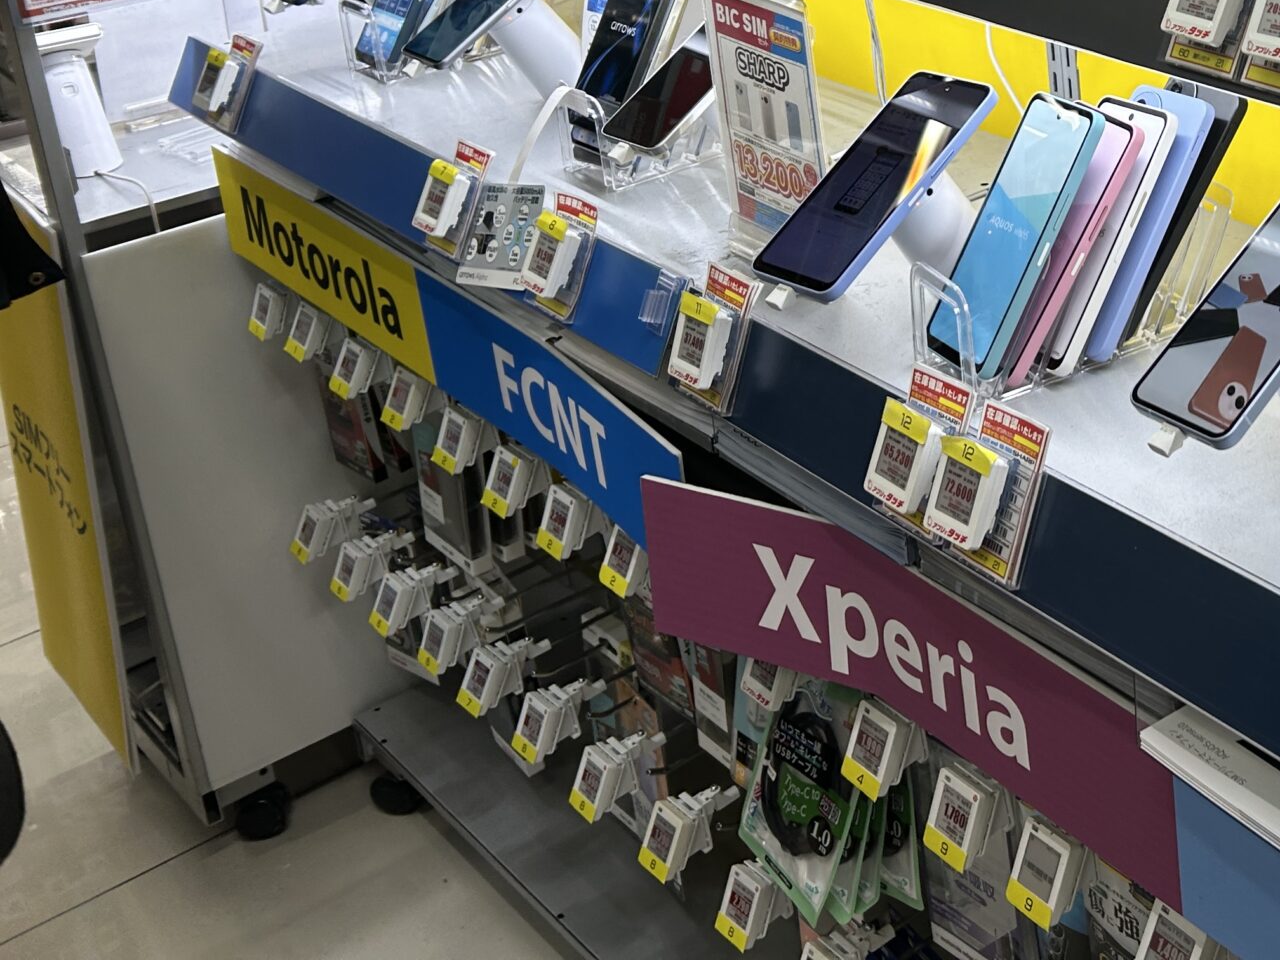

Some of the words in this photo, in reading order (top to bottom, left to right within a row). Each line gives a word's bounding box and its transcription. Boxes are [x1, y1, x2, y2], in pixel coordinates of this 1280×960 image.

[610, 20, 637, 37] arrows
[715, 2, 740, 28] BIC
[742, 13, 768, 39] SIM
[737, 48, 788, 88] SHARP
[989, 215, 1015, 233] AQUOS
[240, 186, 404, 341] Motorola
[492, 342, 607, 490] FCNT
[901, 412, 912, 430] 12
[937, 411, 961, 427] SHARP
[962, 443, 975, 461] 12
[1011, 449, 1035, 466] SHARP
[752, 542, 1032, 772] Xperia
[774, 744, 819, 779] USBケーブル
[783, 773, 811, 800] Type-C
[811, 789, 820, 802] to
[940, 842, 949, 856] 9
[1023, 897, 1034, 912] 9
